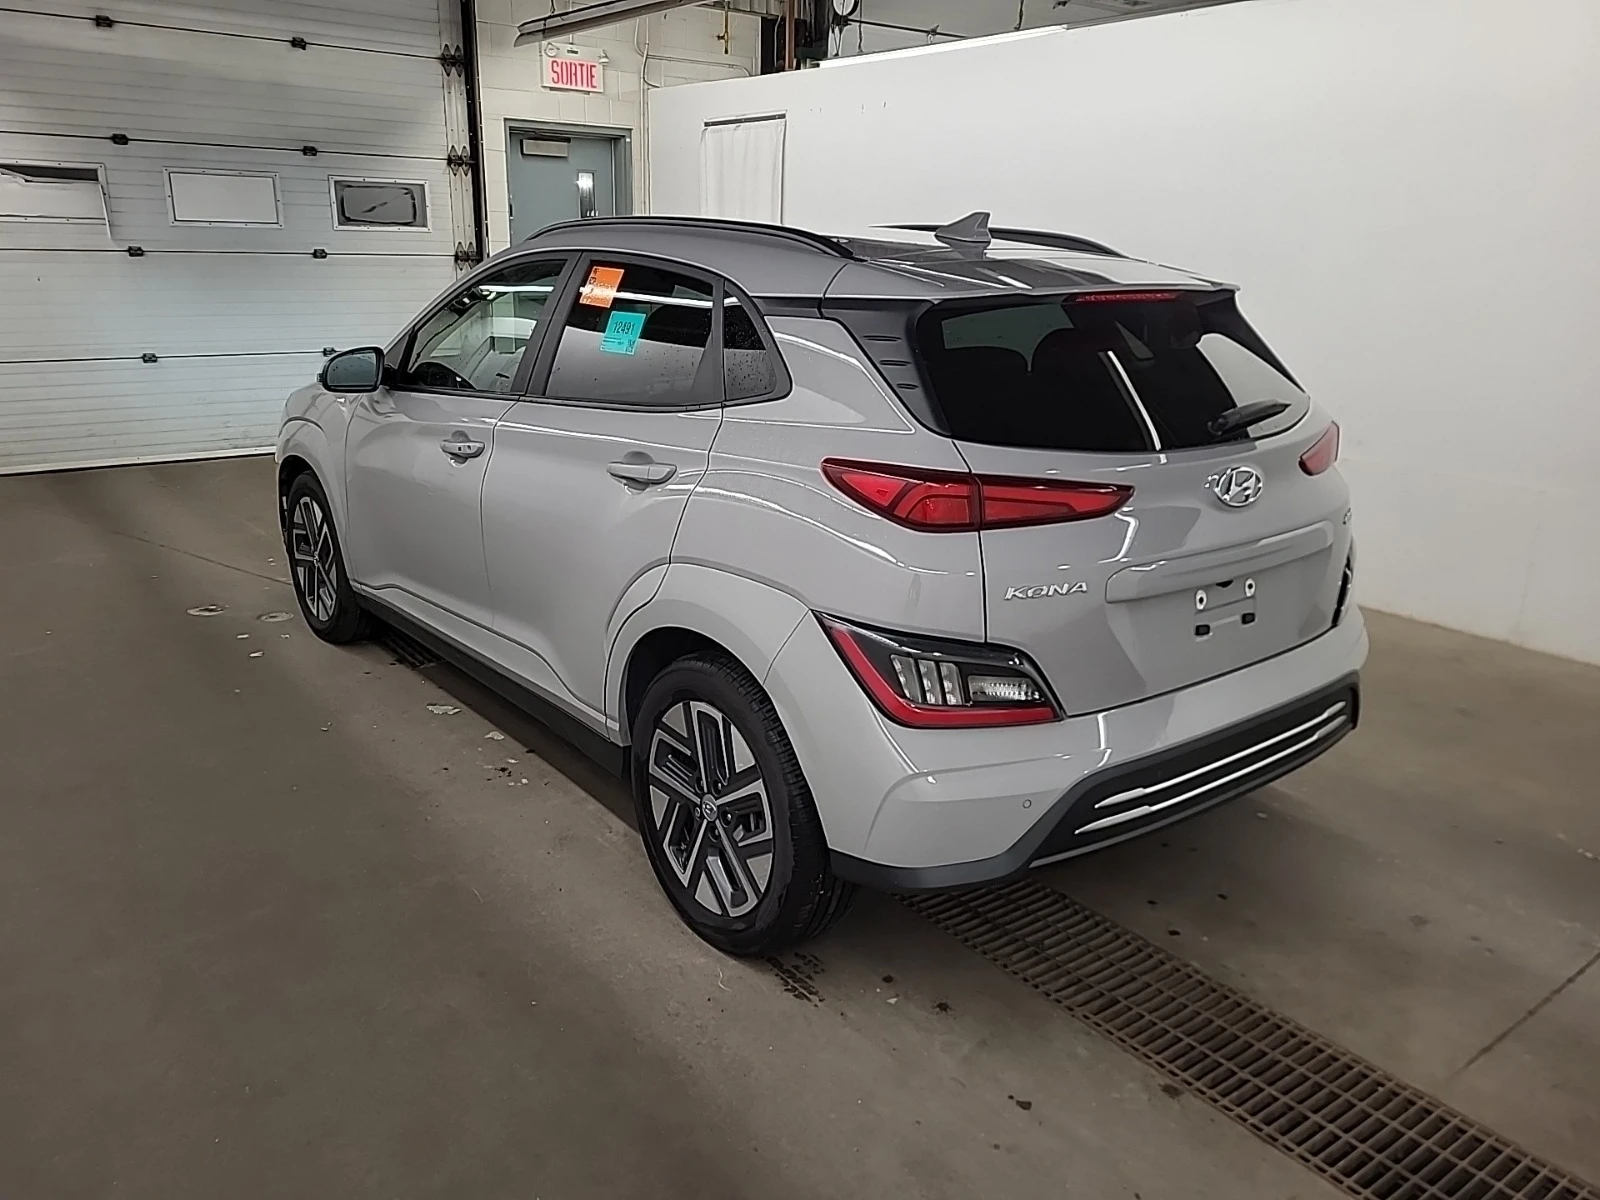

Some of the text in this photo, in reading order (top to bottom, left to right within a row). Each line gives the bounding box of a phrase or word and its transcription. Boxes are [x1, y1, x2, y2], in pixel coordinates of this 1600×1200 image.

[551, 60, 597, 88] SORTIE
[613, 320, 636, 335] 12491
[1004, 582, 1088, 600] KONA
